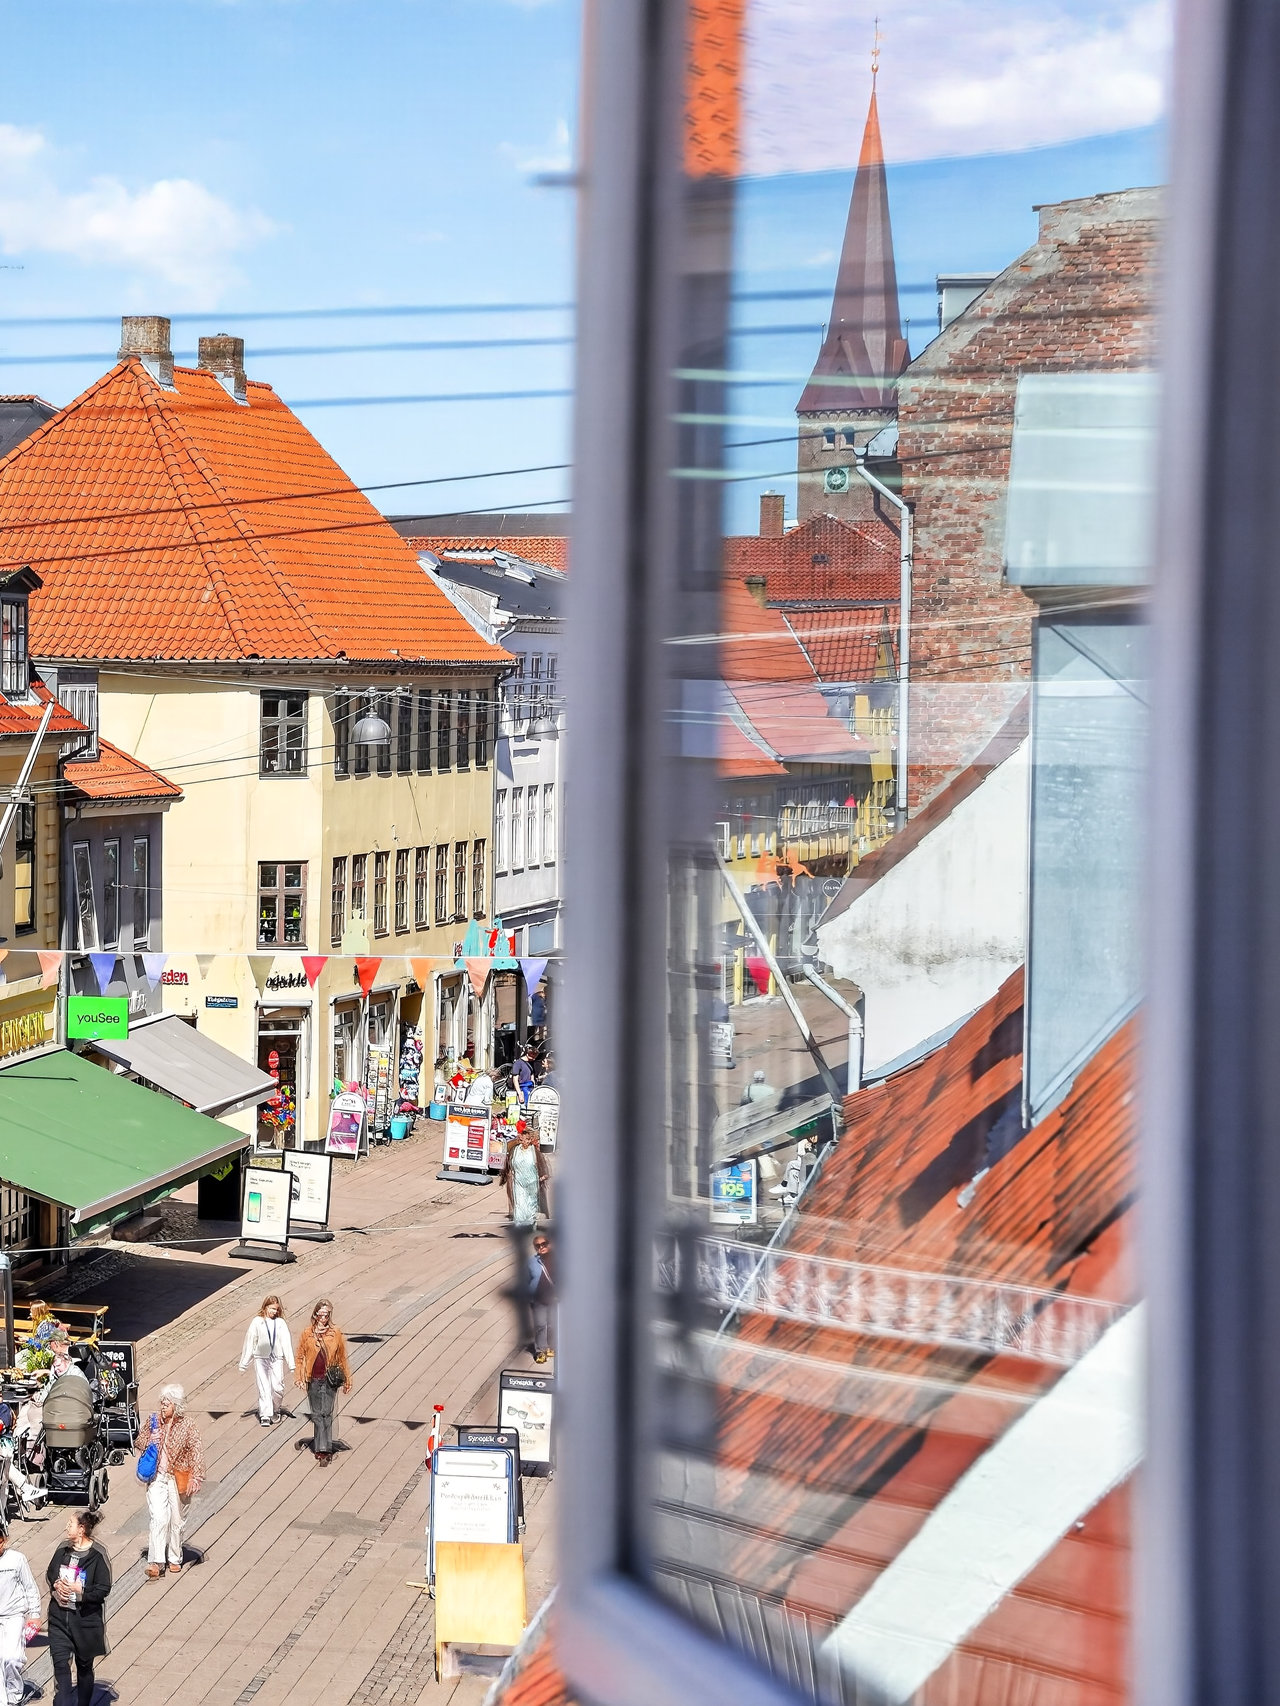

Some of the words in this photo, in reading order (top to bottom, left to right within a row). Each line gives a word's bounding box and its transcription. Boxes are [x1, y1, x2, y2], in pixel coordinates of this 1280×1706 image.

[77, 1012, 120, 1025] youSee
[721, 1183, 745, 1197] 195
[467, 1435, 495, 1443] Synoptik
